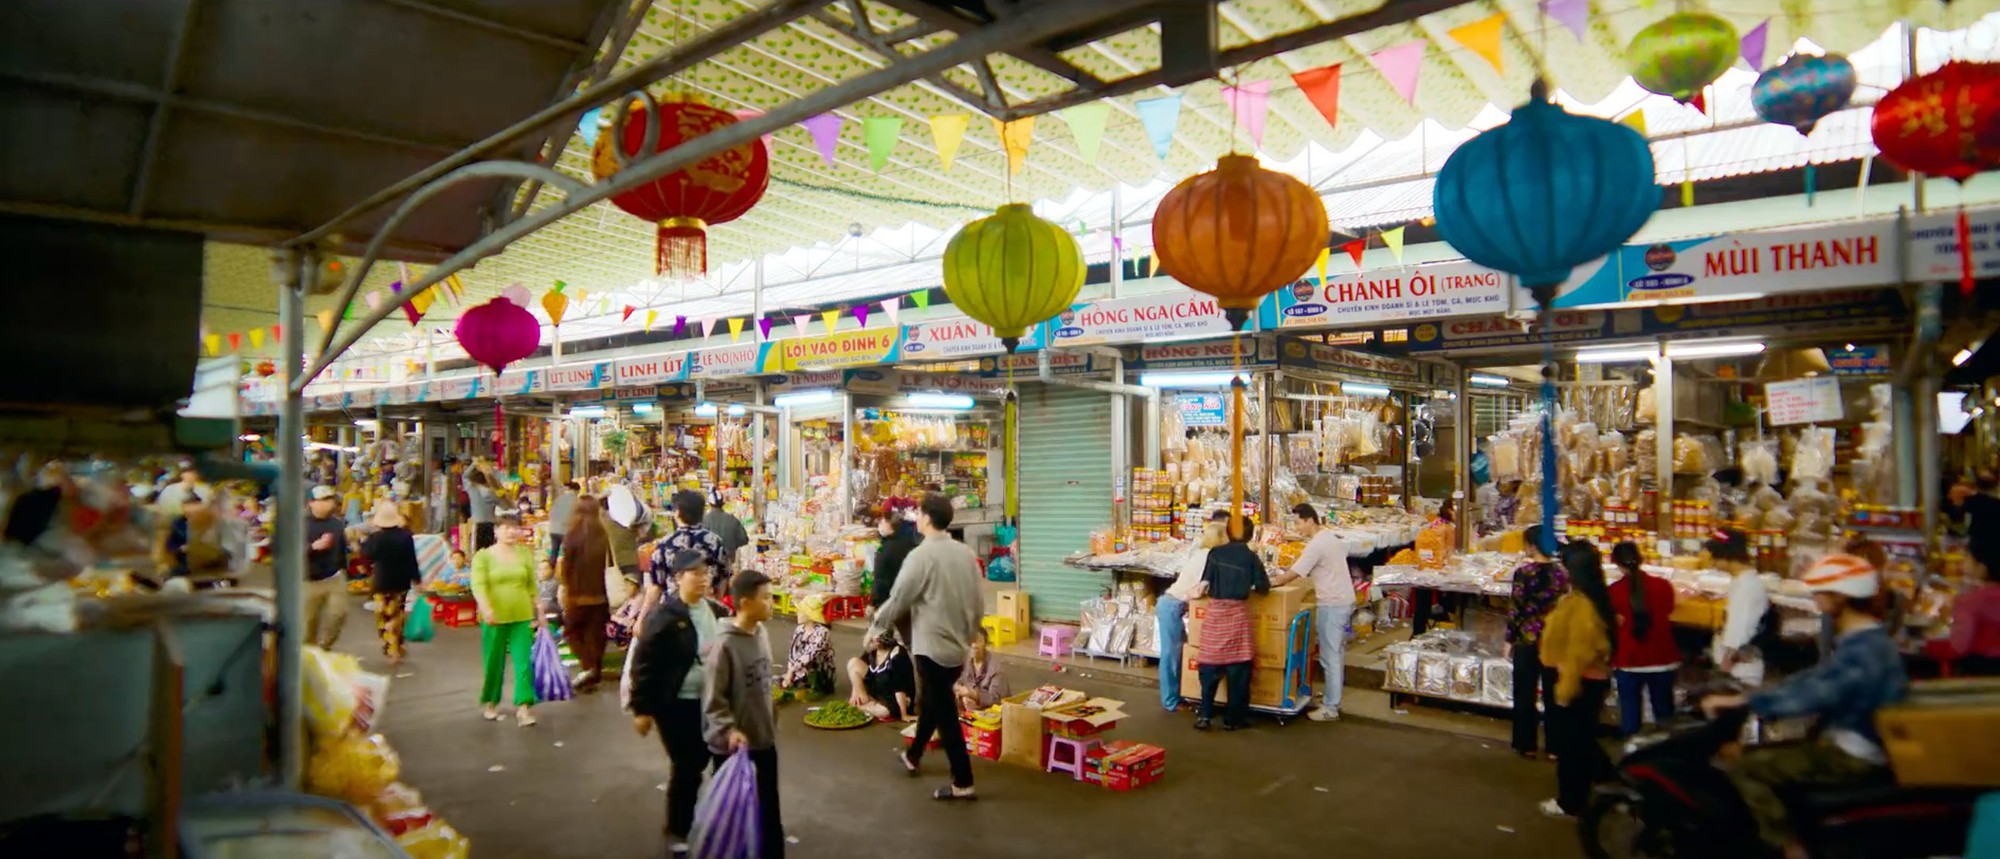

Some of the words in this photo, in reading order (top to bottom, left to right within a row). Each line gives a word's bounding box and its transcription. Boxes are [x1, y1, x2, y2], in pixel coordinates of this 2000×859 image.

[1704, 239, 1760, 278] MÙI
[1769, 236, 1879, 272] THANH
[1323, 274, 1402, 304] CHÁNH
[1409, 270, 1436, 297] ÔI
[1440, 272, 1501, 293] (TRANG)
[882, 334, 890, 348] 6
[929, 320, 977, 343] XUÂN
[621, 361, 657, 378] LINH
[664, 355, 684, 373] ÚT
